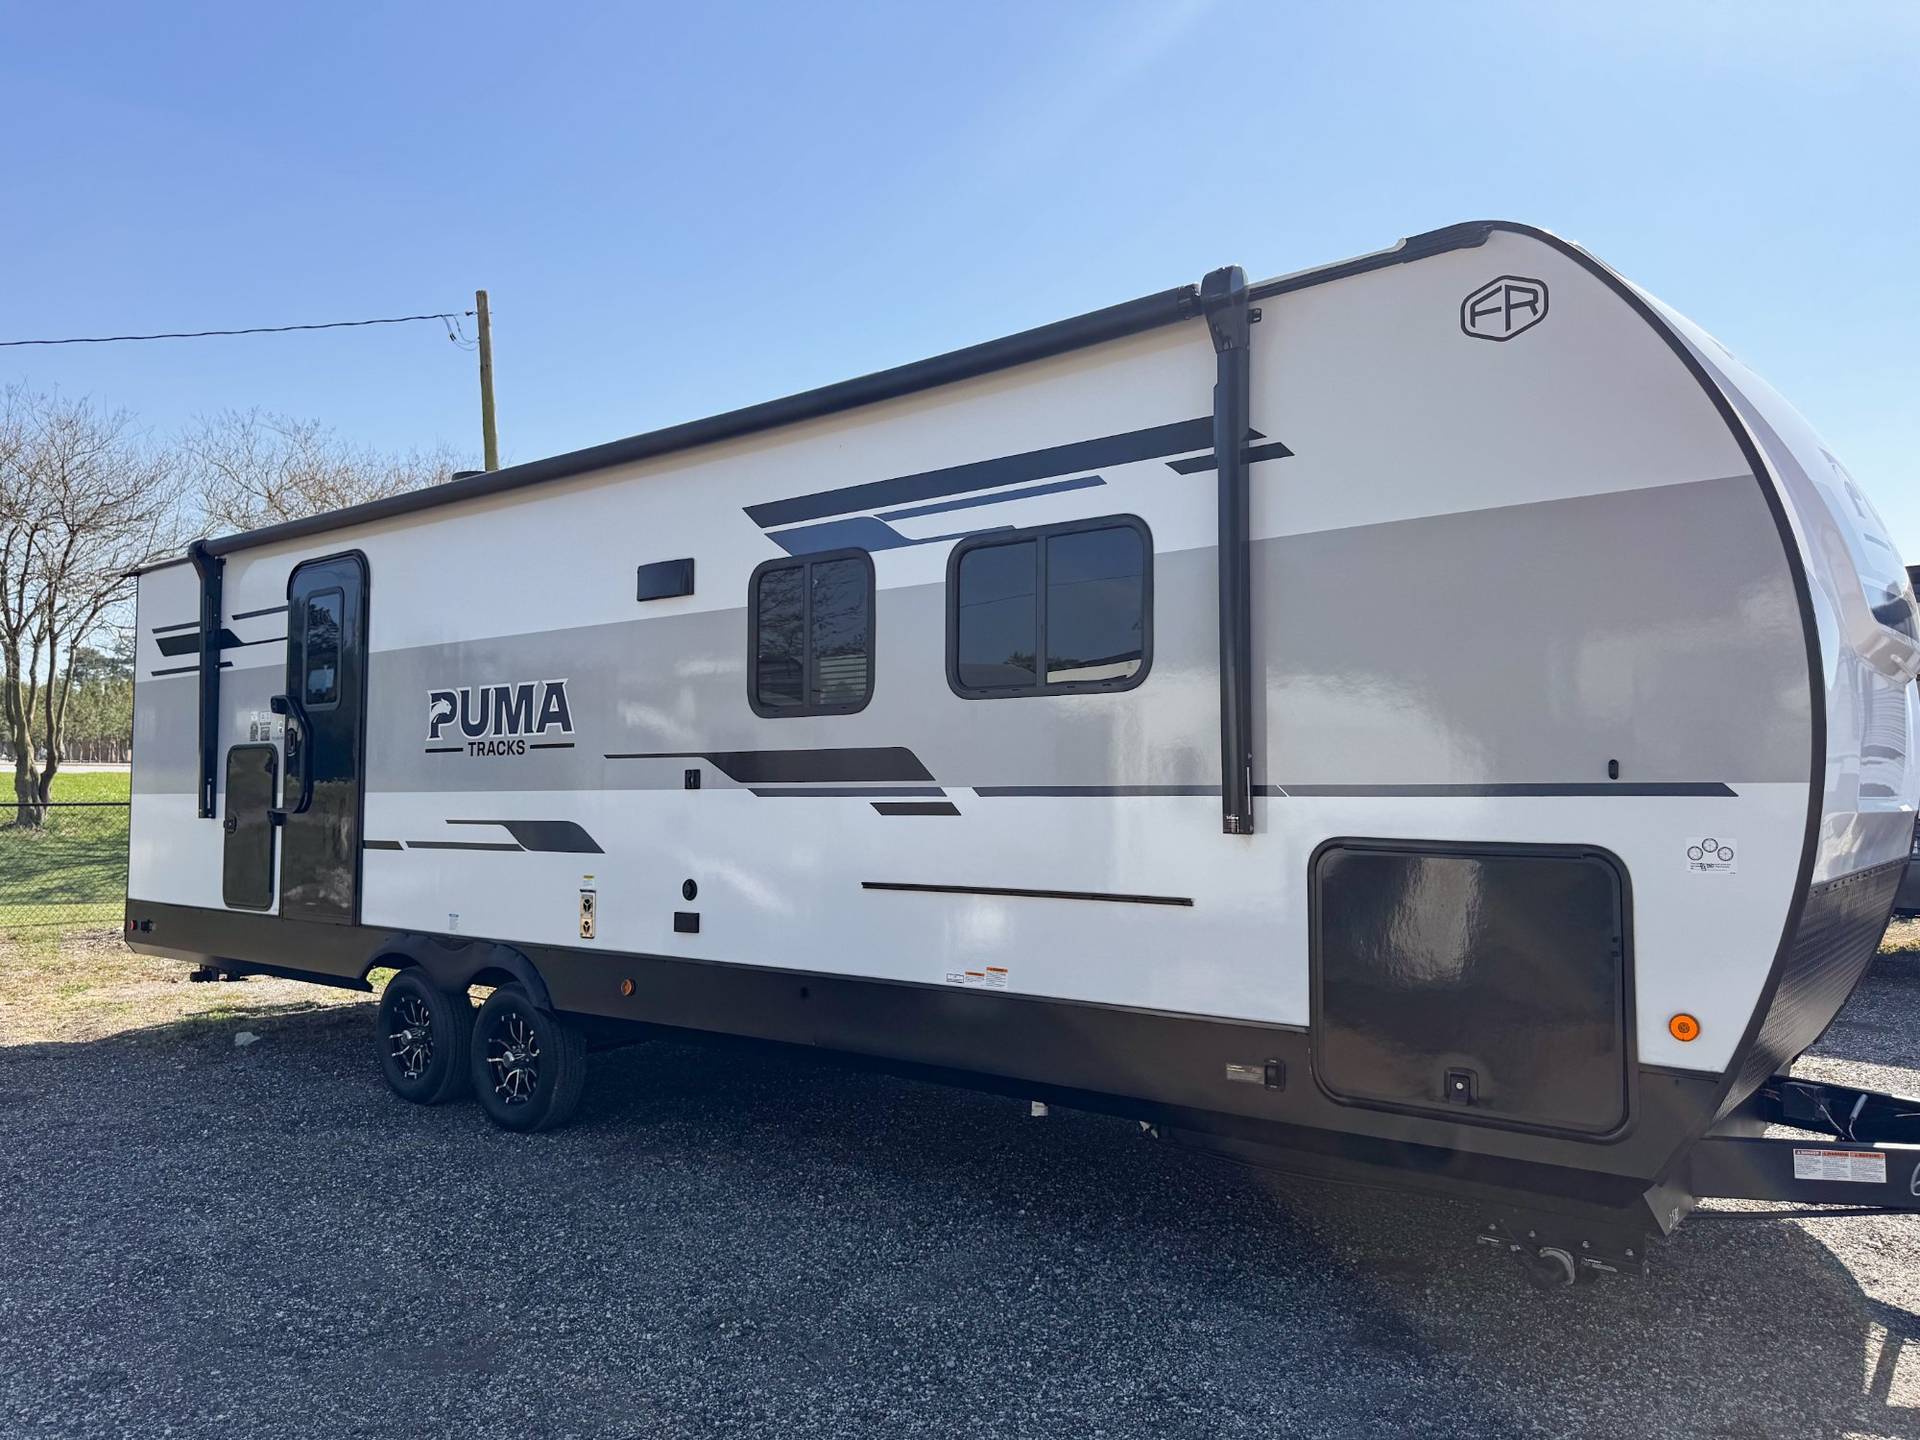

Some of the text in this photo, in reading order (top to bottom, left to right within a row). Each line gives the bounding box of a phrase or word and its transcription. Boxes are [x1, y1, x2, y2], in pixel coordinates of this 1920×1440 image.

[1470, 284, 1539, 332] FR
[426, 678, 575, 741] PUMA
[468, 740, 525, 756] TRACKS
